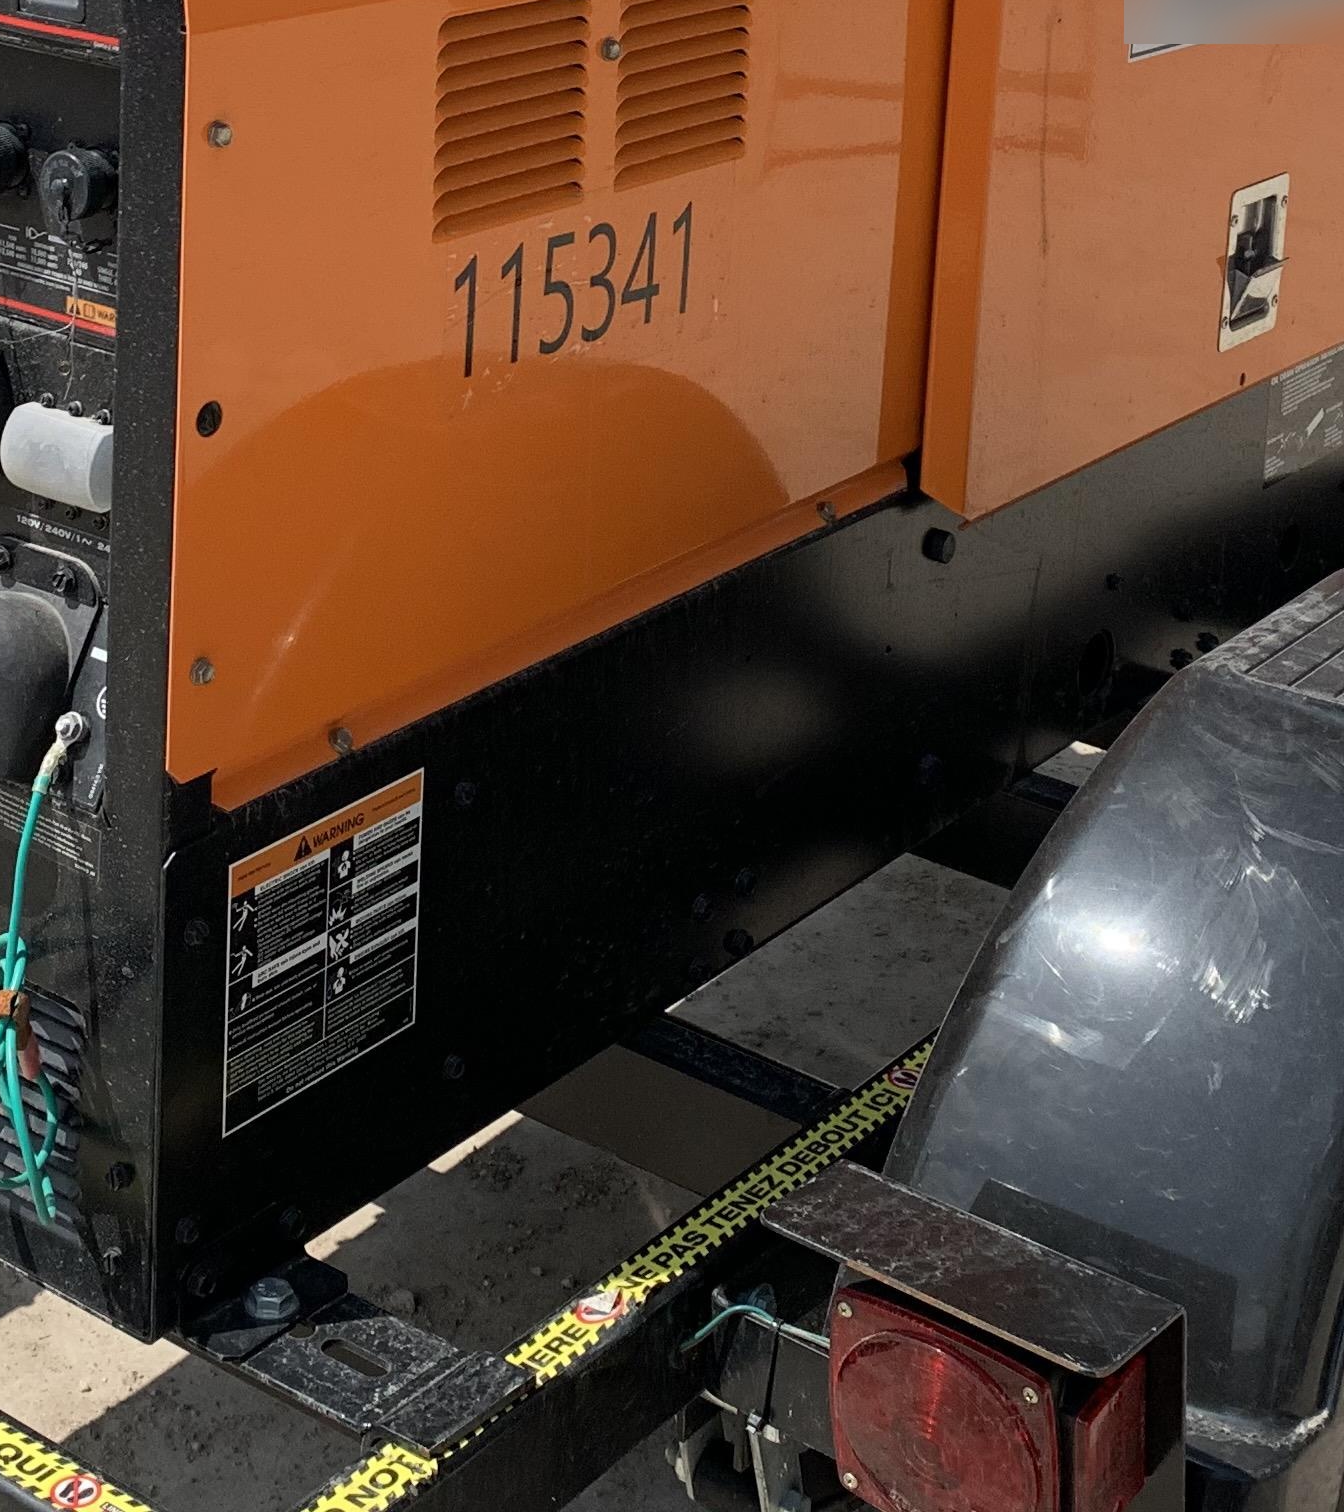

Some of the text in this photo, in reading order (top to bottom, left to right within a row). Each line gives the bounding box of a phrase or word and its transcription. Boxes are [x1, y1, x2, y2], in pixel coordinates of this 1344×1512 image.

[454, 201, 693, 378] 115341
[312, 812, 365, 848] WARNING
[616, 1086, 902, 1290] NE PAS TENEZ DEBOUT ICI
